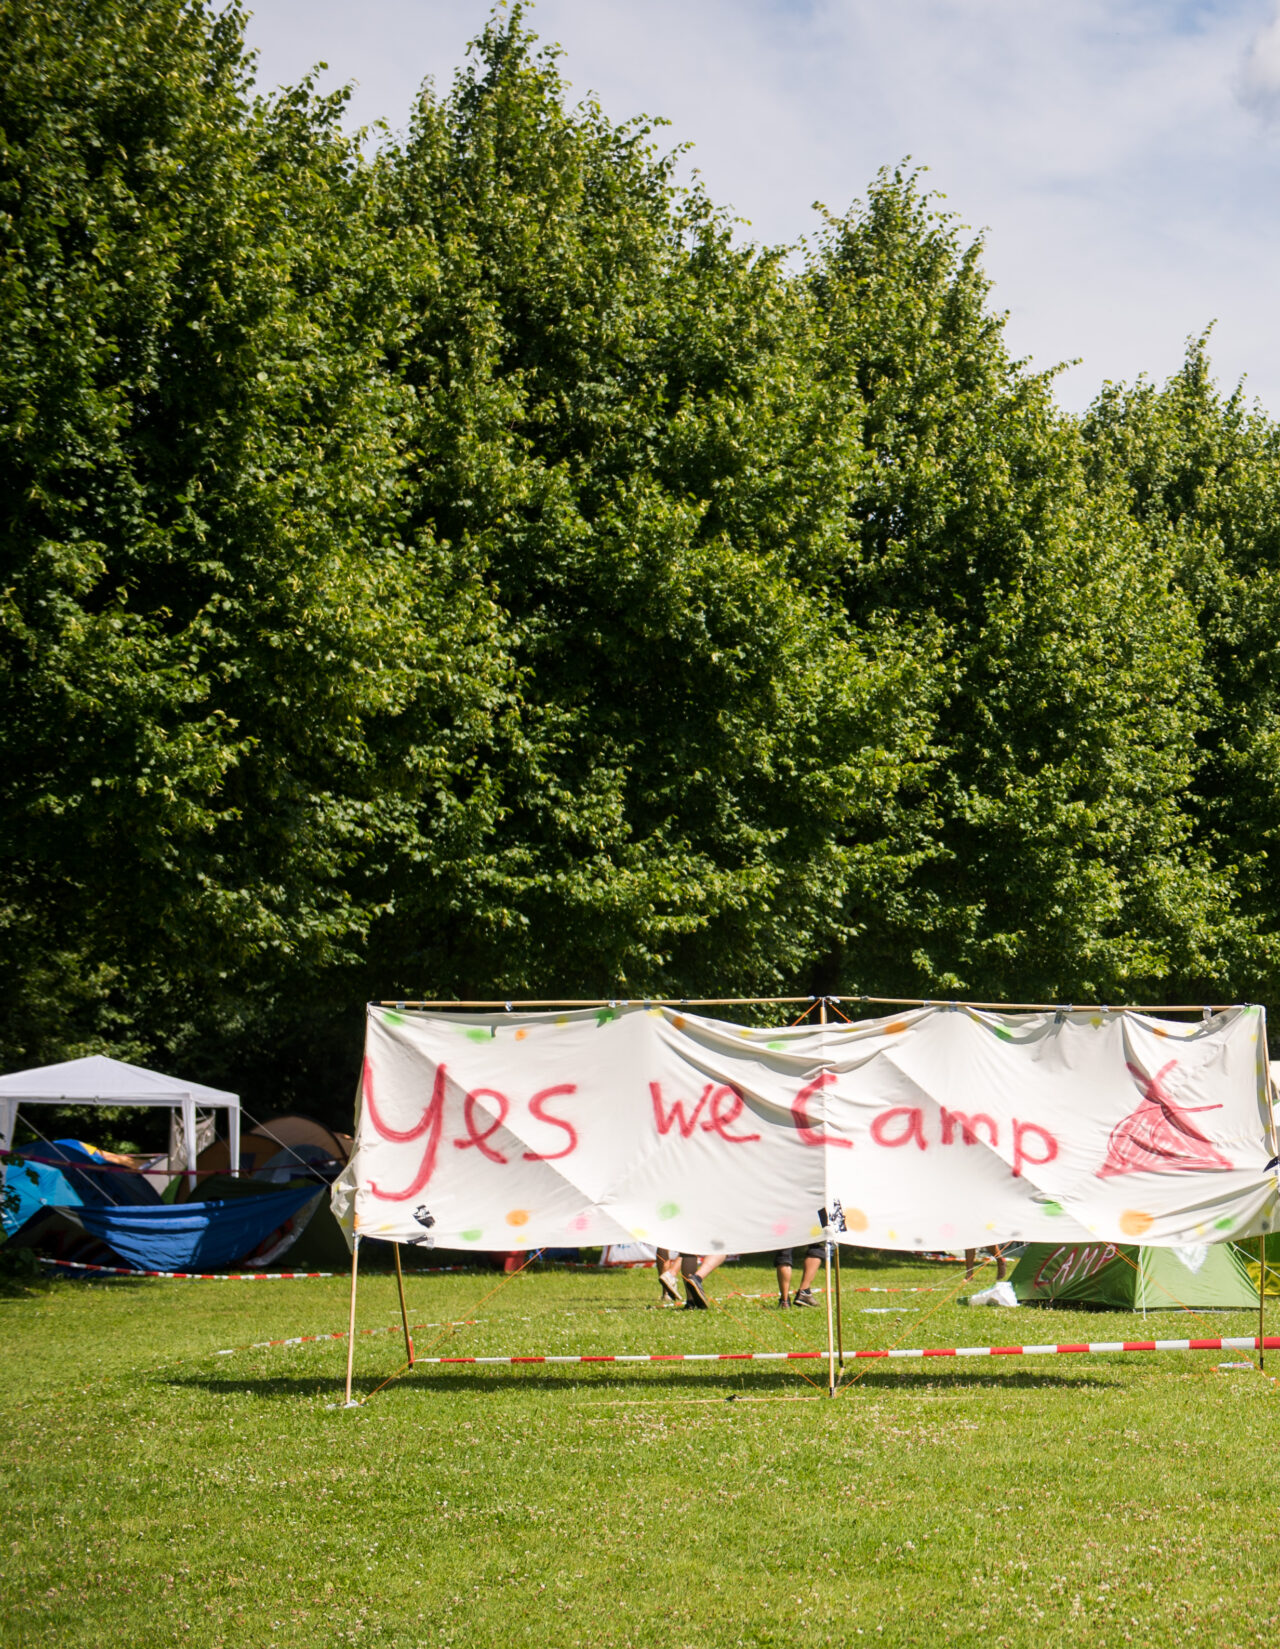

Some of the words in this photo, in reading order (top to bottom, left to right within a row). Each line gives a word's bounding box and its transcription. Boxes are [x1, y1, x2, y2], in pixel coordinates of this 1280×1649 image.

[363, 1055, 578, 1202] Yes
[649, 1081, 761, 1143] we
[790, 1073, 1060, 1178] Camp
[1034, 1243, 1118, 1289] CAMP
